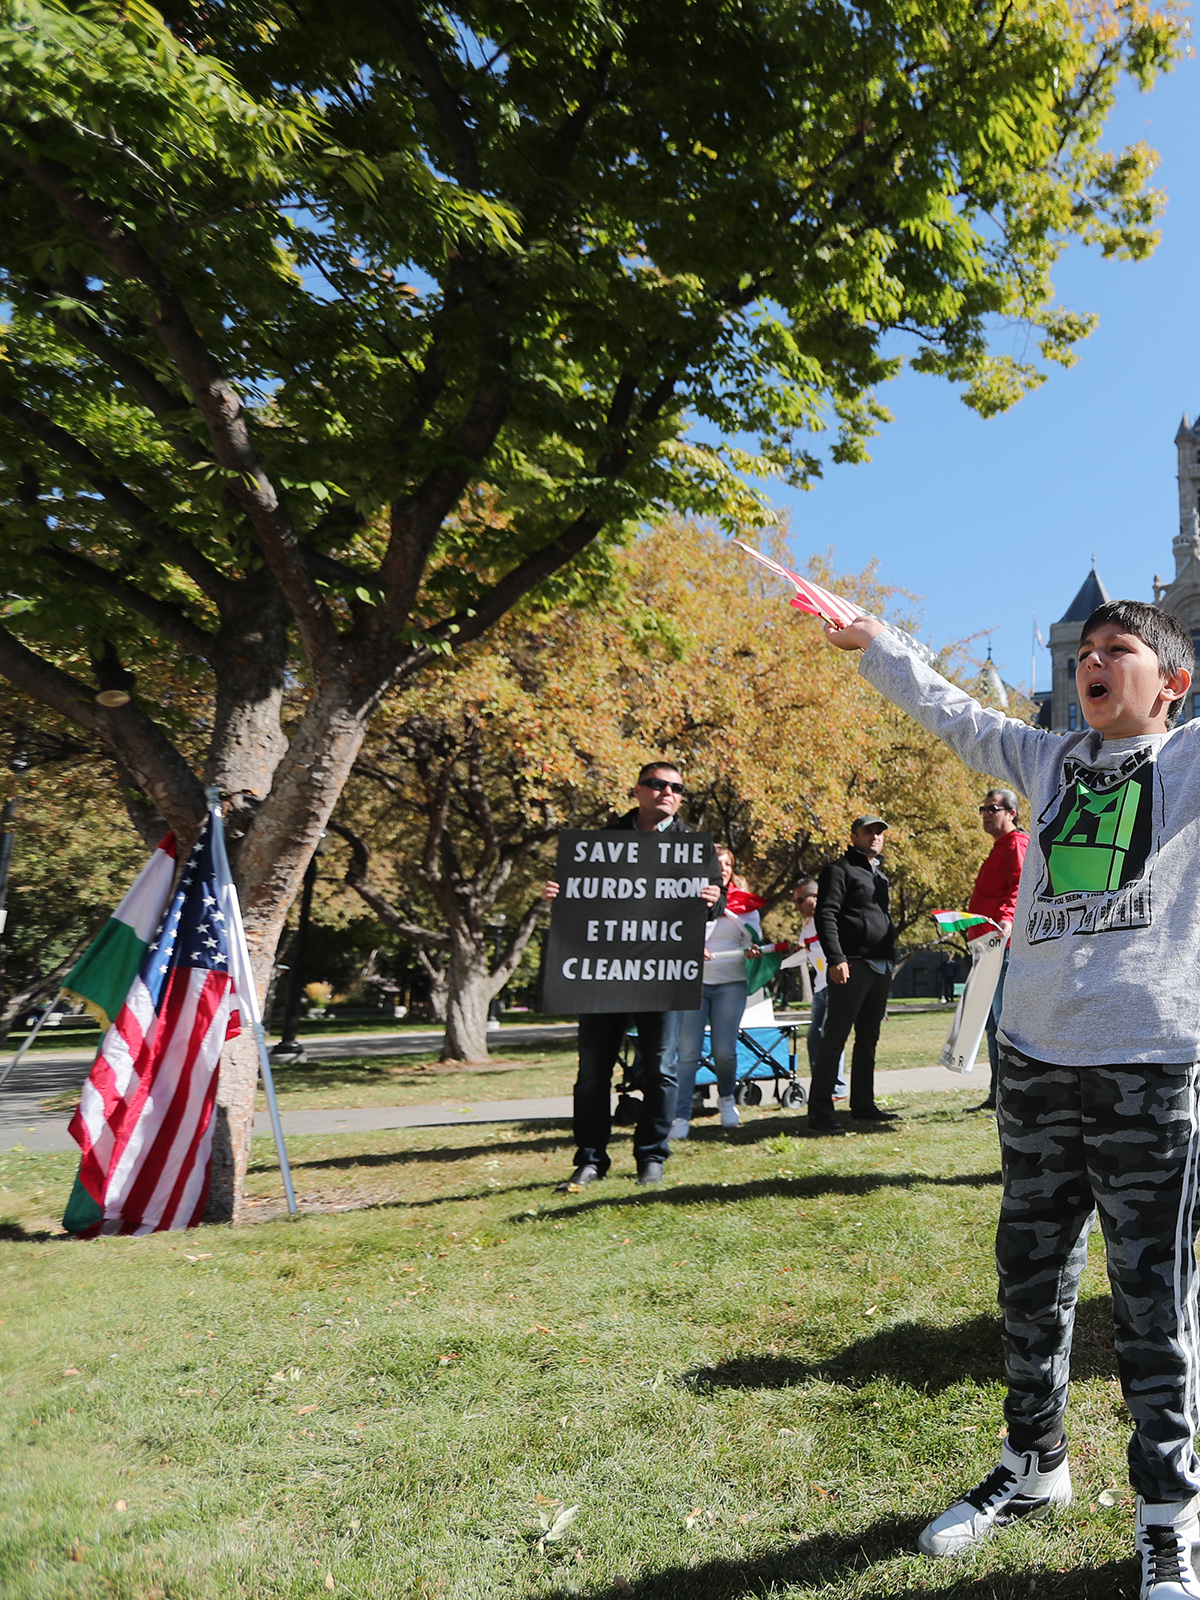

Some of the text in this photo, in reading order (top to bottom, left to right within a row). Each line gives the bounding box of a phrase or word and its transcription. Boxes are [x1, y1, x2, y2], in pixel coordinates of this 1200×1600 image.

[573, 841, 704, 864] SAVE THE
[565, 877, 709, 899] KURDS FROM
[587, 920, 683, 942] ETHNIC
[562, 958, 699, 981] CLEANSING
